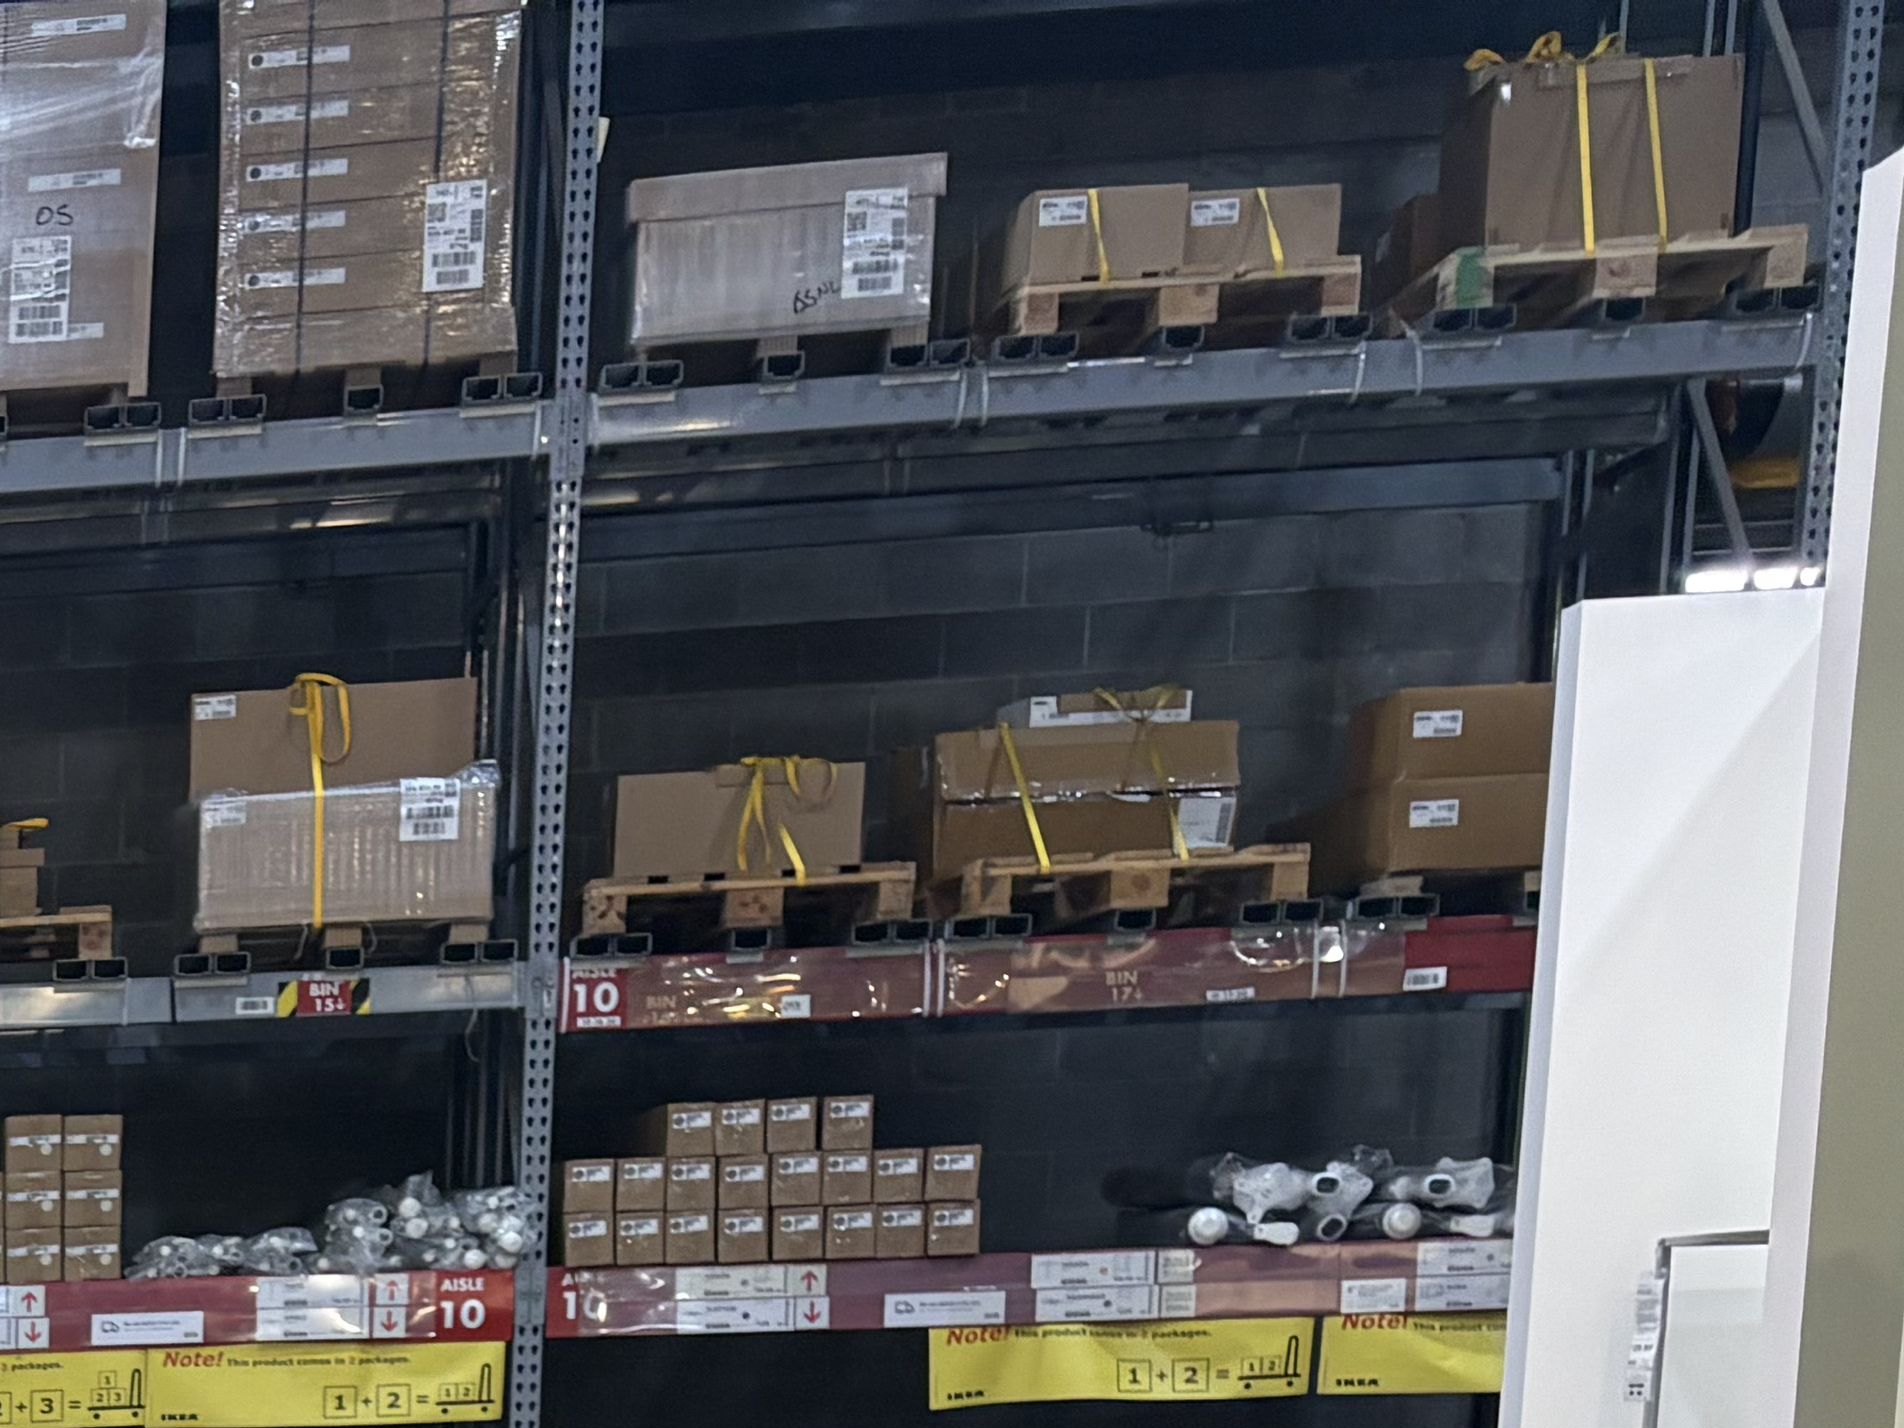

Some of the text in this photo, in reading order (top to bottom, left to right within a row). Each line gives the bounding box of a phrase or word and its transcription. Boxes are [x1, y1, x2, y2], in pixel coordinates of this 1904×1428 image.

[1105, 970, 1138, 986] BIN
[309, 982, 340, 997] BIN
[573, 982, 620, 1013] 10
[315, 999, 335, 1012] 15
[440, 1278, 485, 1292] AISLE
[440, 1299, 486, 1329] 10
[1341, 1313, 1408, 1330] Note!
[946, 1326, 1010, 1346] Note!
[163, 1351, 223, 1368] Note!
[1128, 1366, 1198, 1384] 1 2
[40, 1399, 54, 1414] 3
[334, 1393, 400, 1410] 1 2
